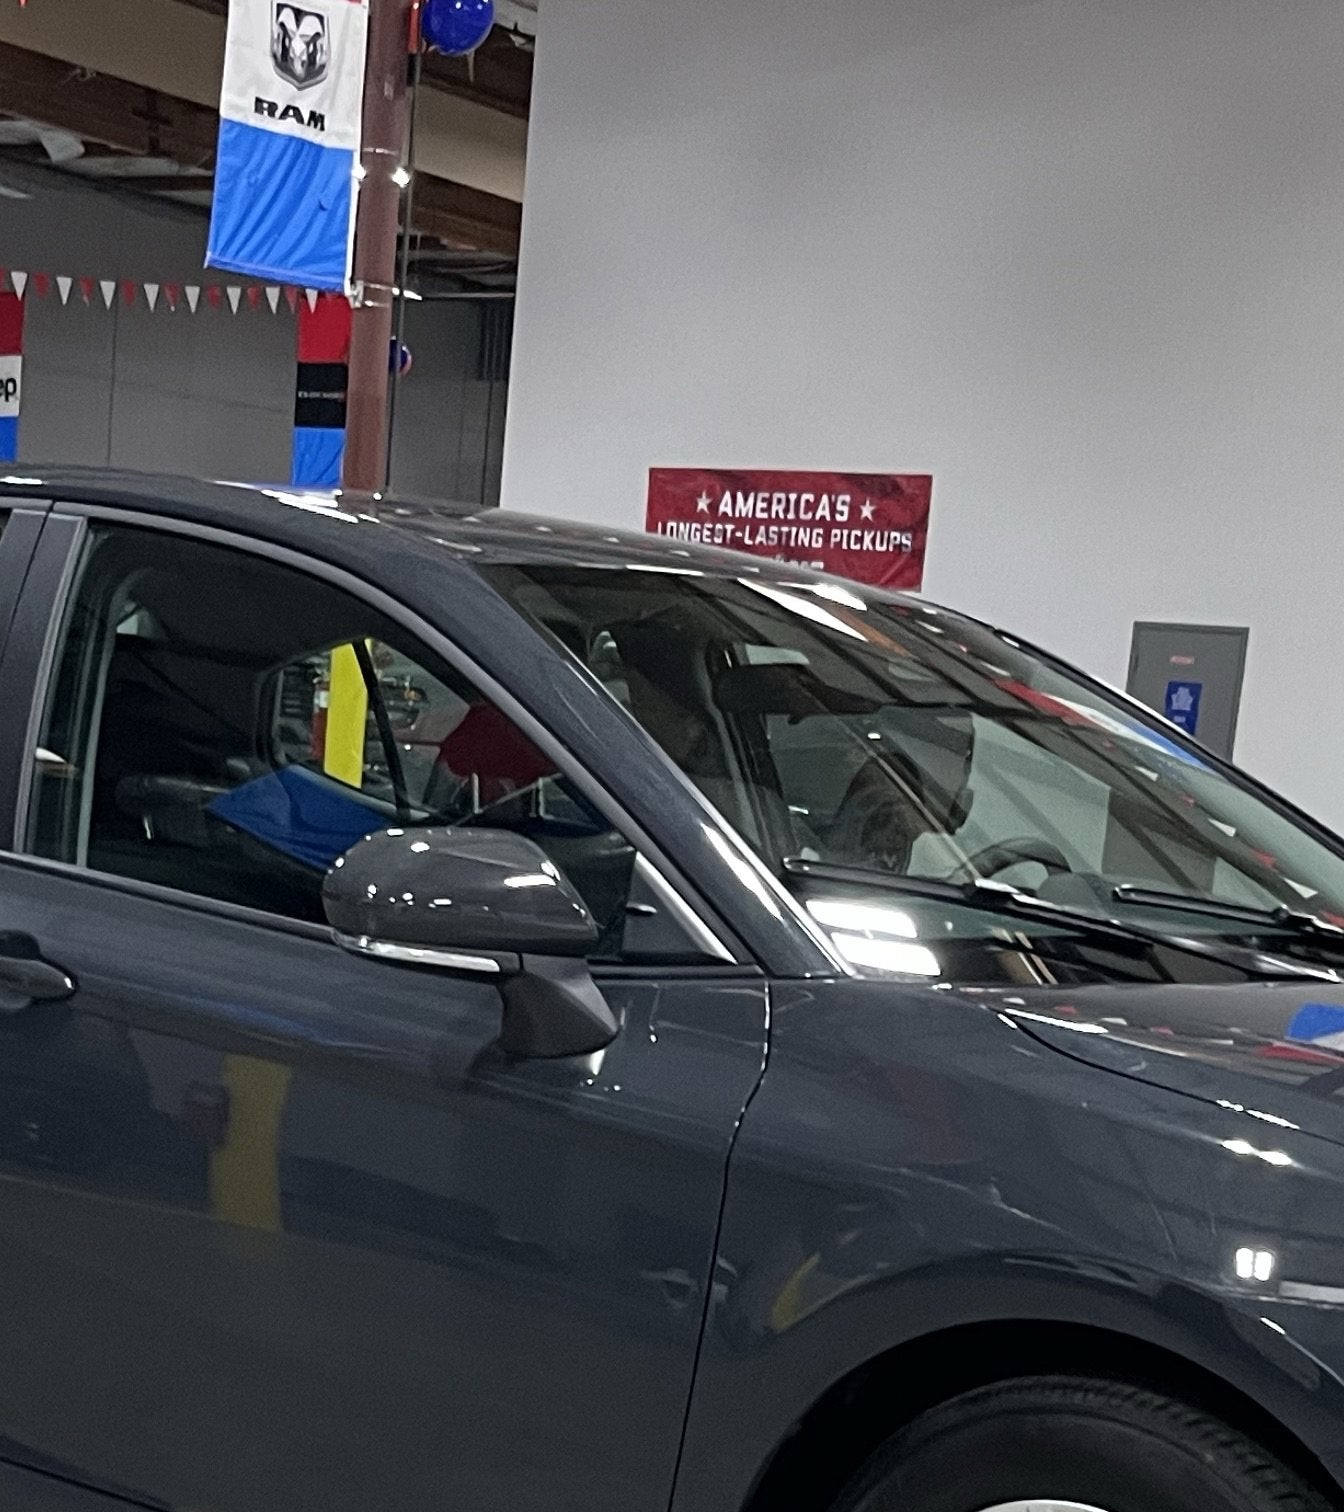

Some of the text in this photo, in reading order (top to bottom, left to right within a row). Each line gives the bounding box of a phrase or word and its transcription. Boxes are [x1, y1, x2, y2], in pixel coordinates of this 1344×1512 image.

[254, 96, 325, 132] RAM
[718, 491, 851, 522] AMERICA'S
[657, 521, 913, 553] LONGEST-LASTING PICKUPS
